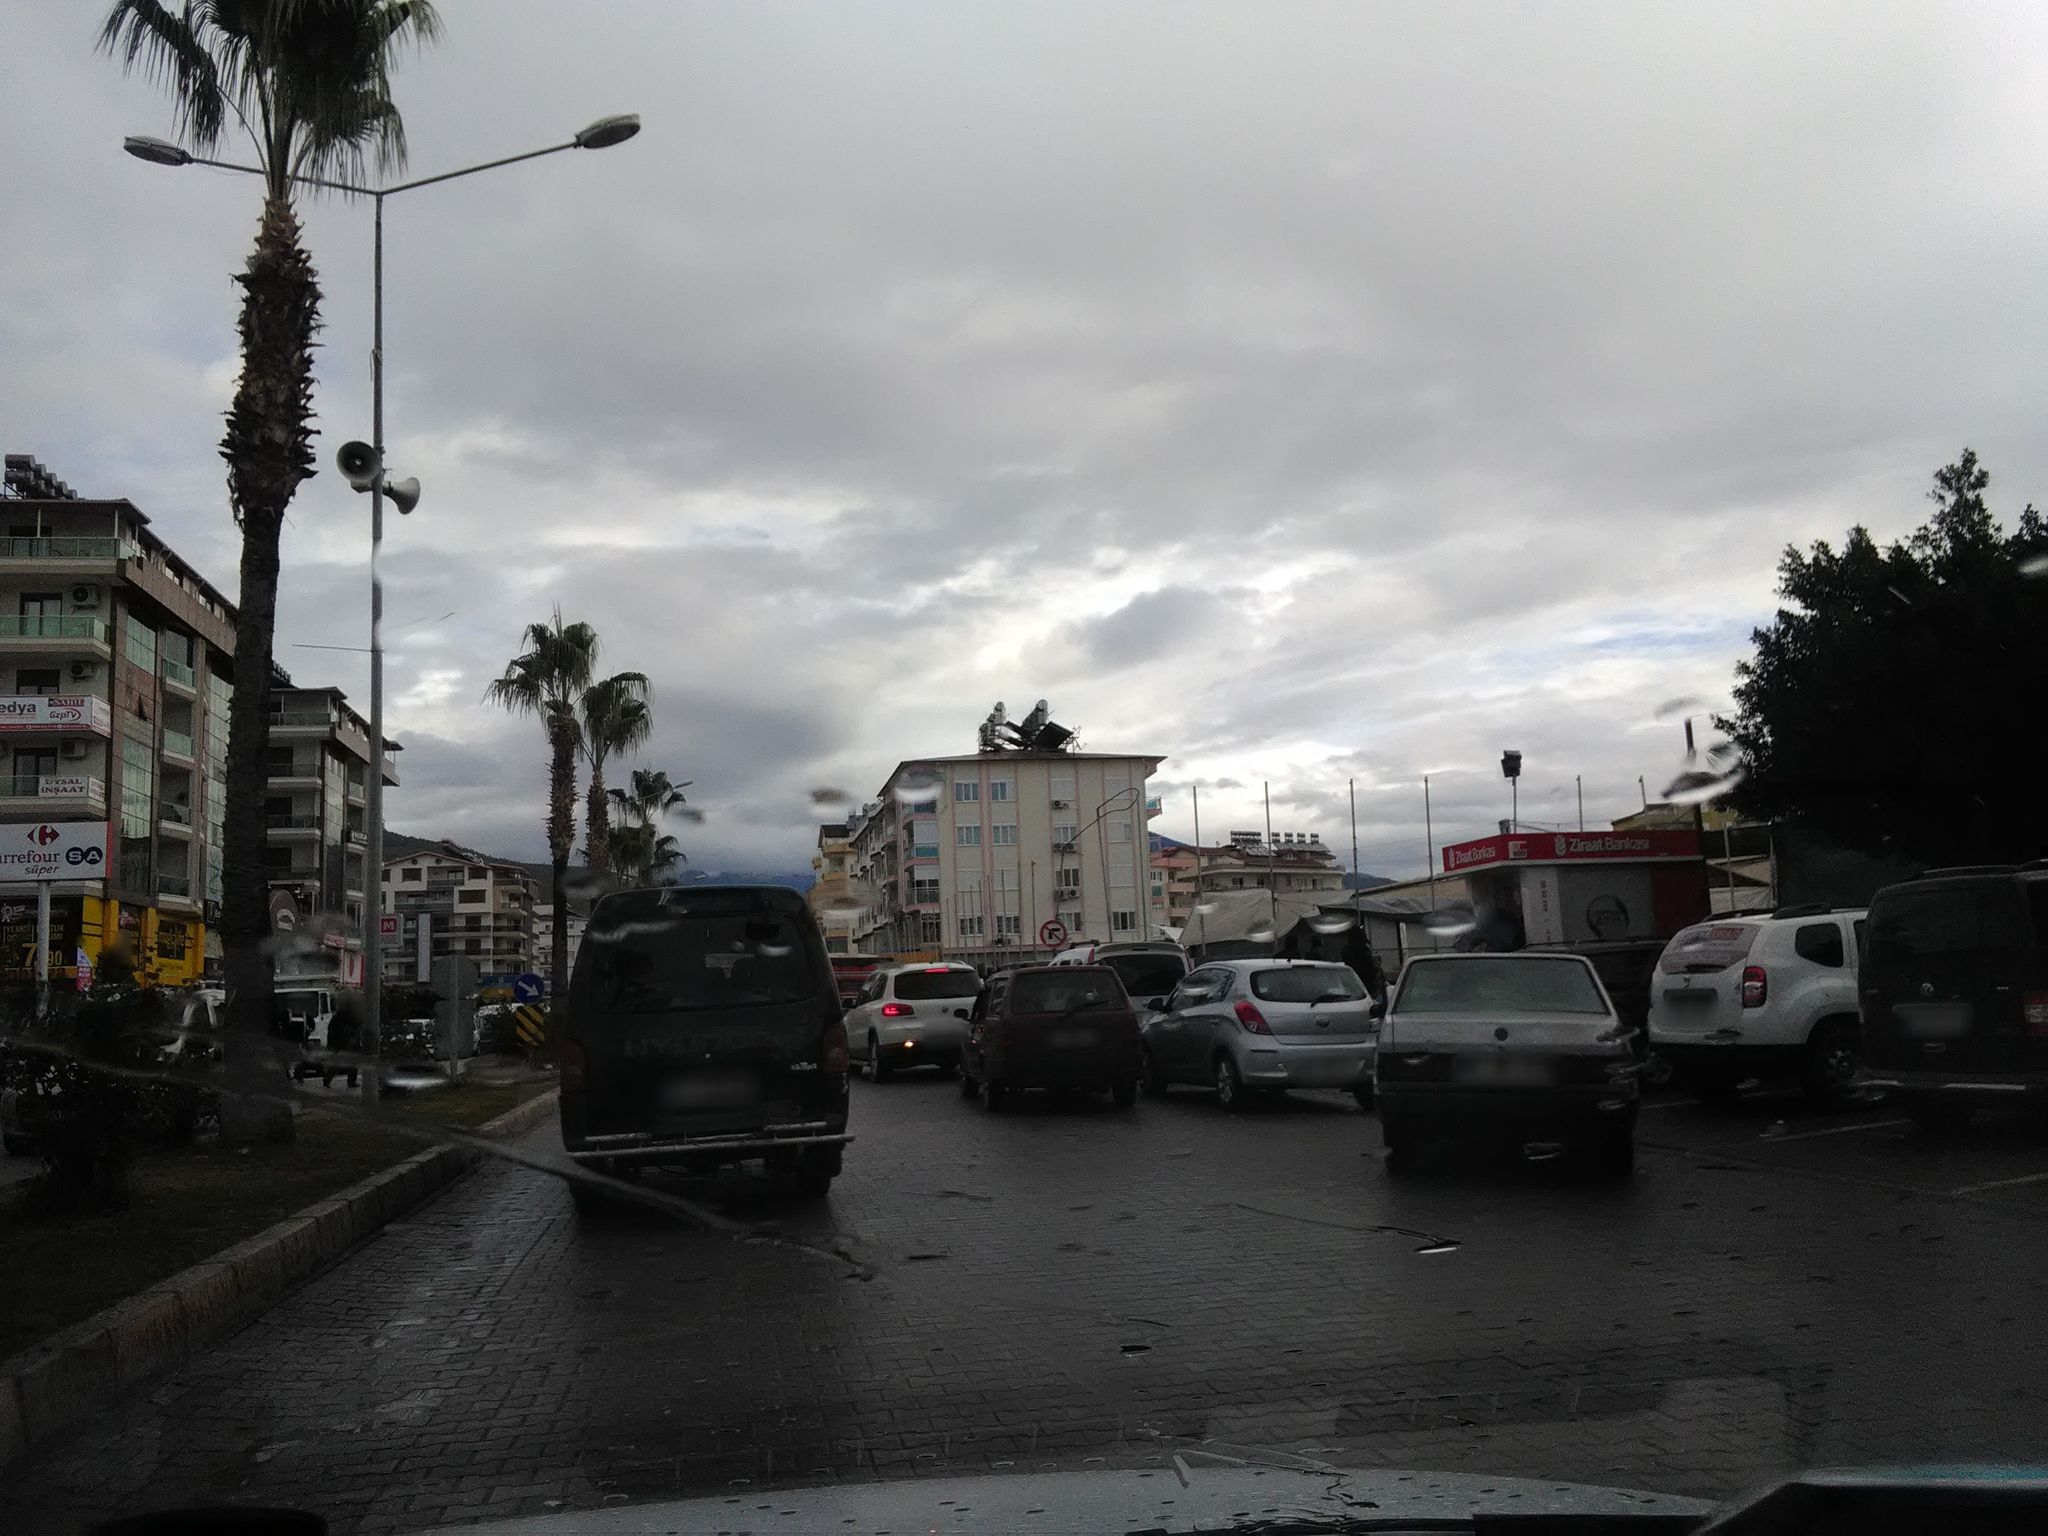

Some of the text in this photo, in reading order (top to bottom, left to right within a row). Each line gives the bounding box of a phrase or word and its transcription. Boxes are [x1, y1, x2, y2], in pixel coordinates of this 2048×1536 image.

[1569, 836, 1650, 852] Ziraat Bankası
[25, 865, 60, 877] süper
